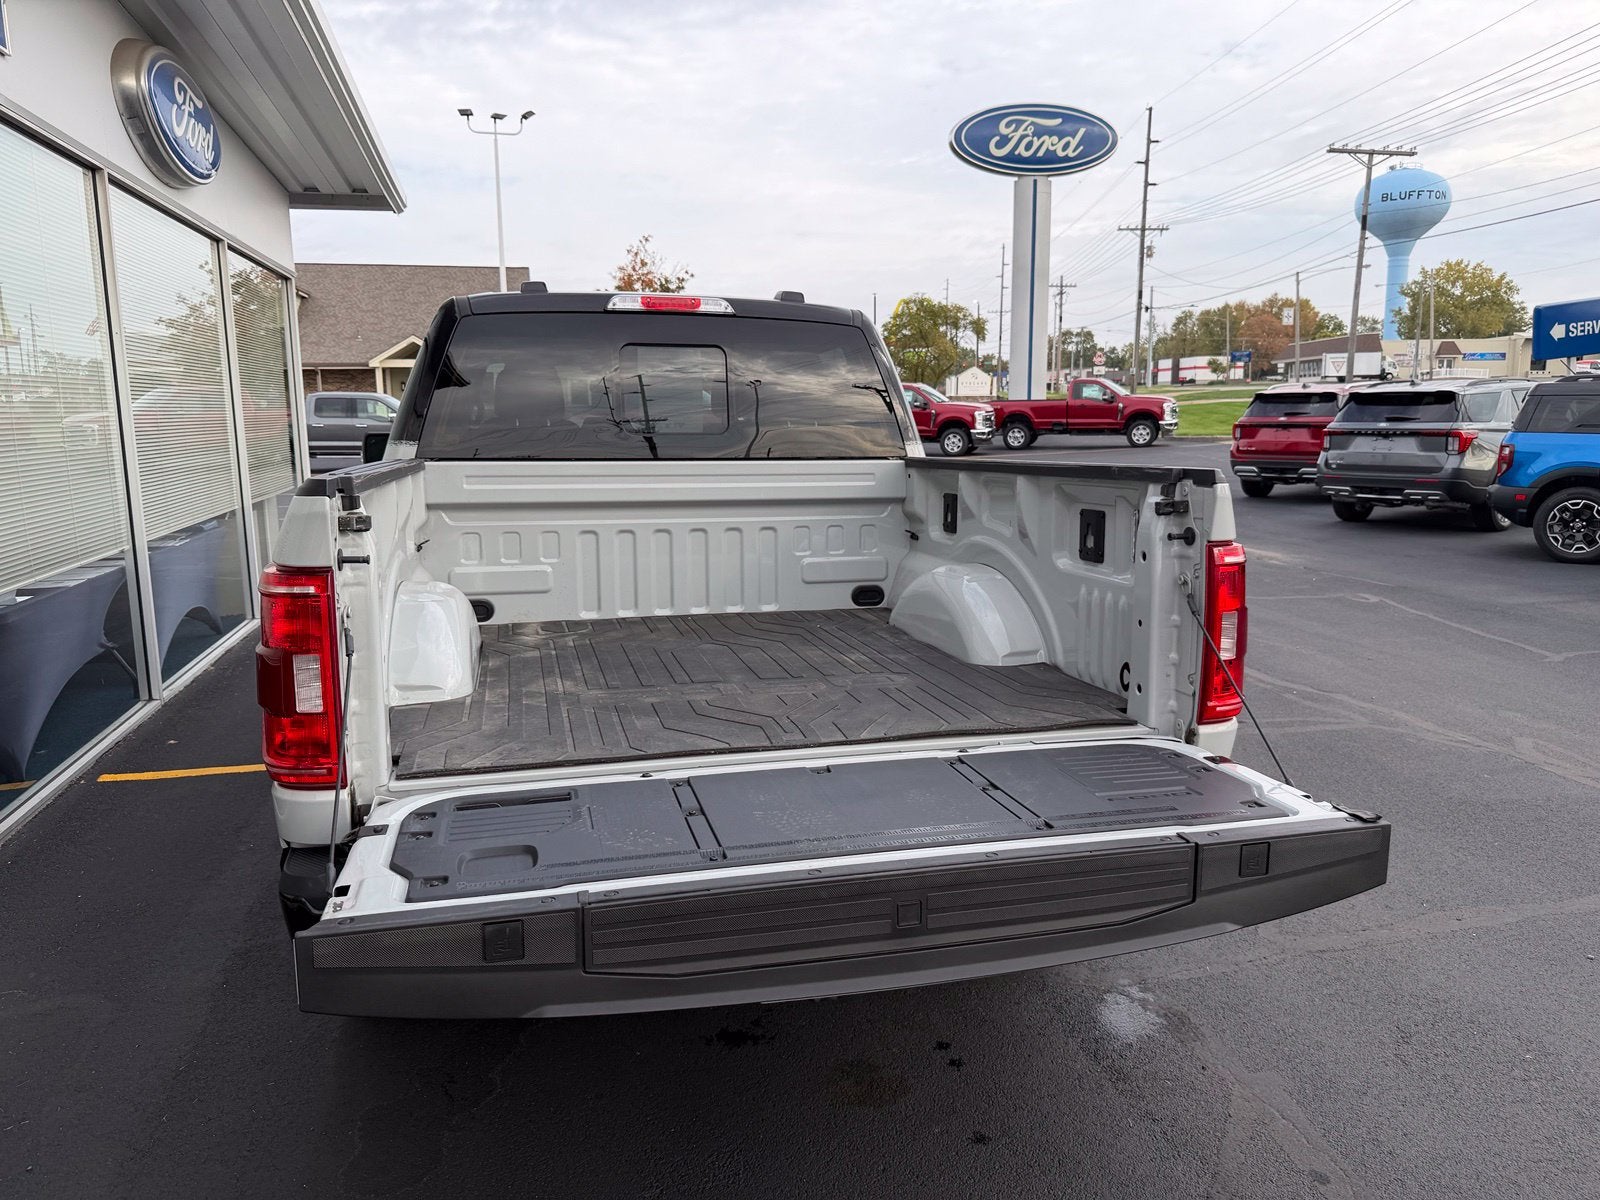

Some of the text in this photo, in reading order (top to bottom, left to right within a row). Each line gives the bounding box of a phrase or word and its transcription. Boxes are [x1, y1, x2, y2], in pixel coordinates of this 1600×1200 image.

[172, 76, 214, 163] Ford
[988, 115, 1087, 158] Ford
[1381, 189, 1447, 202] BLUFFTON
[1568, 319, 1600, 337] SERV
